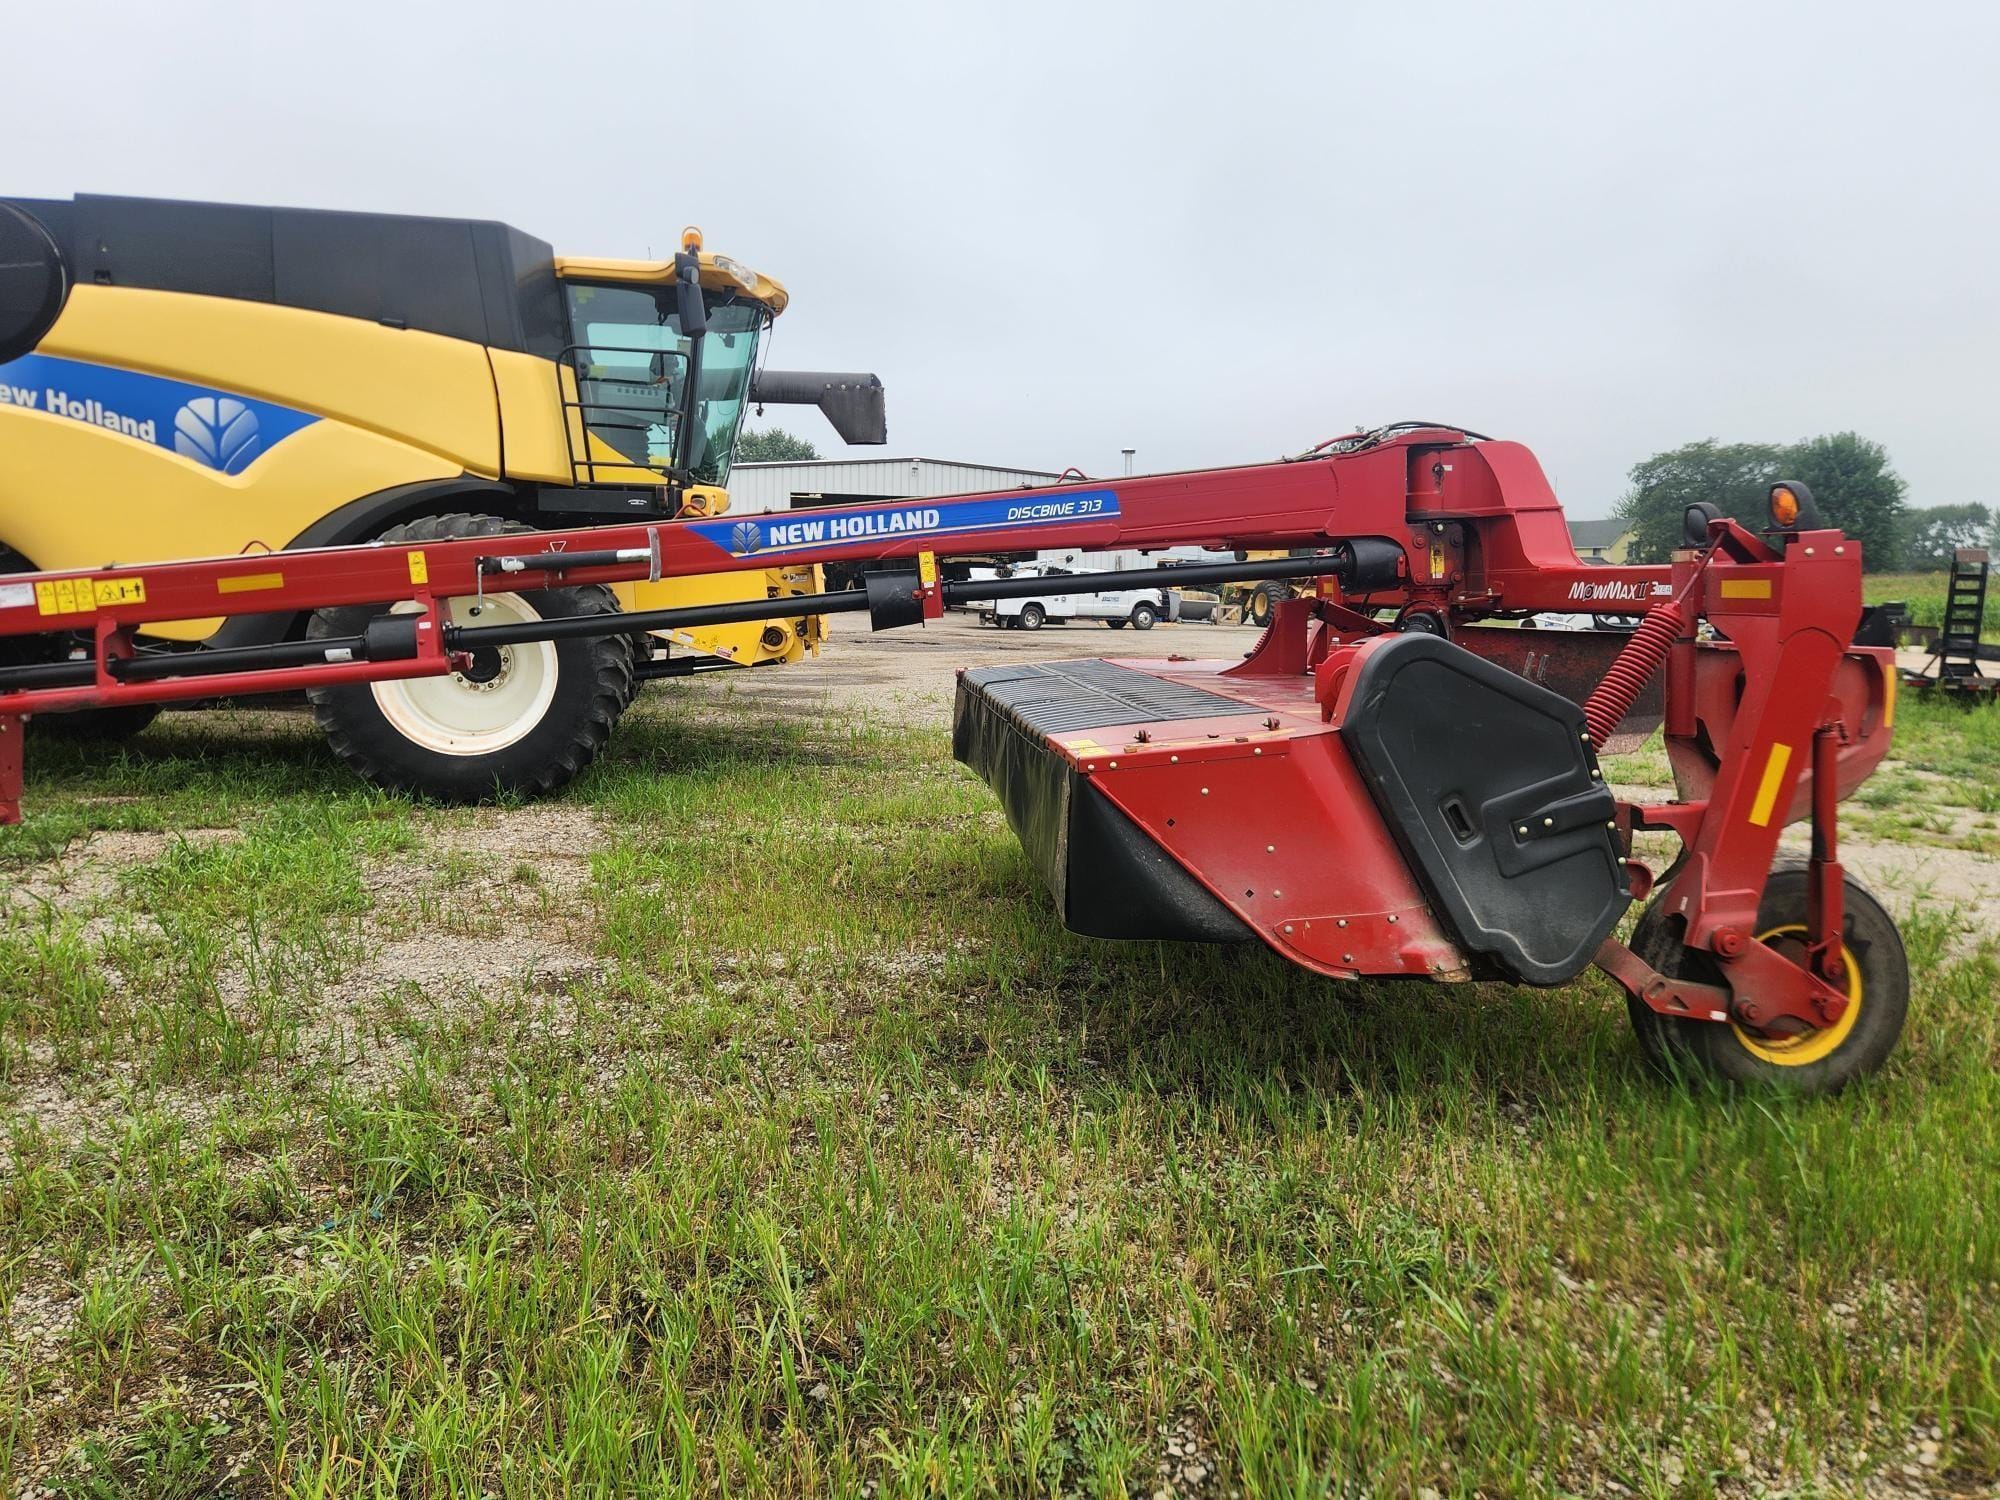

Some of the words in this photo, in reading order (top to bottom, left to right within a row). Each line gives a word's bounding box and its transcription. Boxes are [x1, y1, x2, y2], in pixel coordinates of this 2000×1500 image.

[0, 384, 38, 408] ew
[46, 388, 157, 444] Holland
[770, 521, 824, 546] NEW
[830, 509, 940, 538] HOLLAND
[1008, 502, 1075, 520] DISCBINE
[1078, 499, 1103, 513] 313
